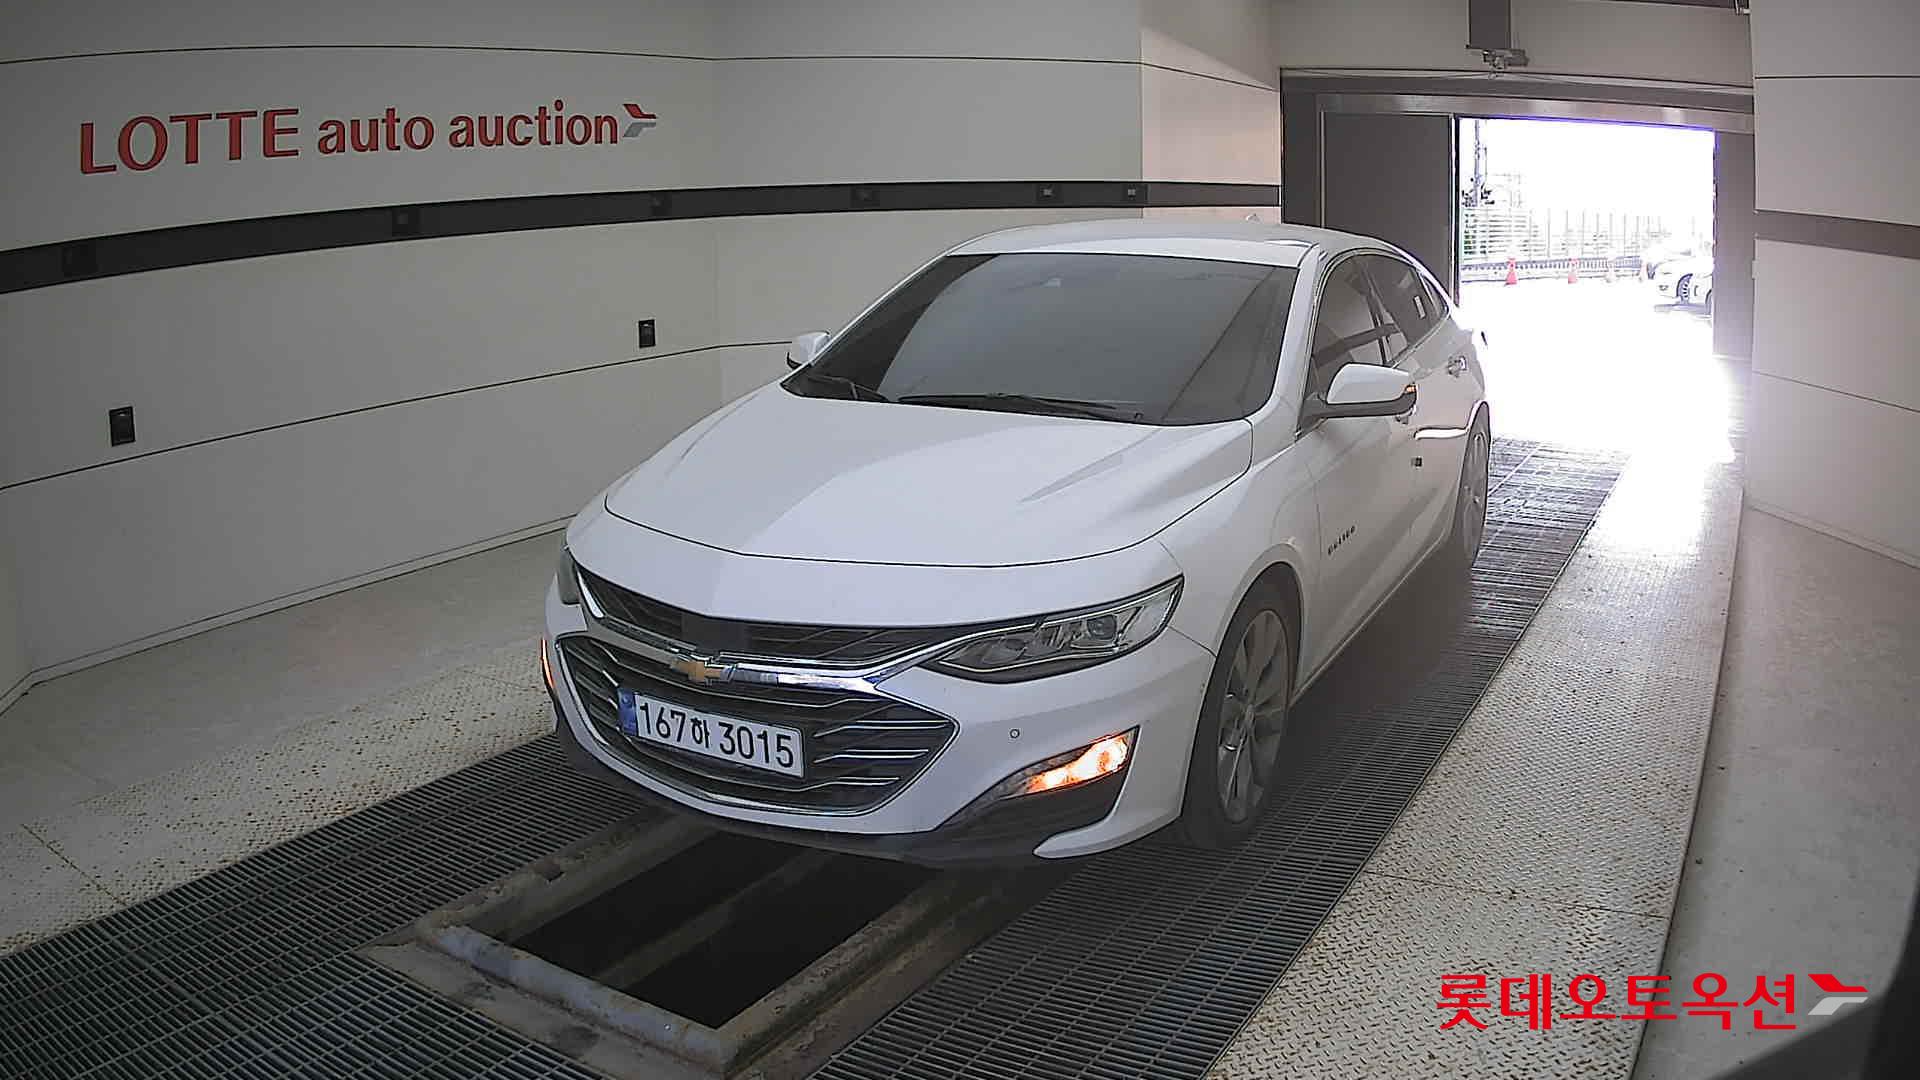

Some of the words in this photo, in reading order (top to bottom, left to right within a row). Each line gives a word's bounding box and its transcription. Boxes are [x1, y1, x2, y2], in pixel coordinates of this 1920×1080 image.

[80, 108, 299, 175] LOTTE
[317, 107, 435, 154] auto
[448, 100, 618, 148] auction
[639, 702, 710, 749] 167하
[718, 721, 794, 768] 3015
